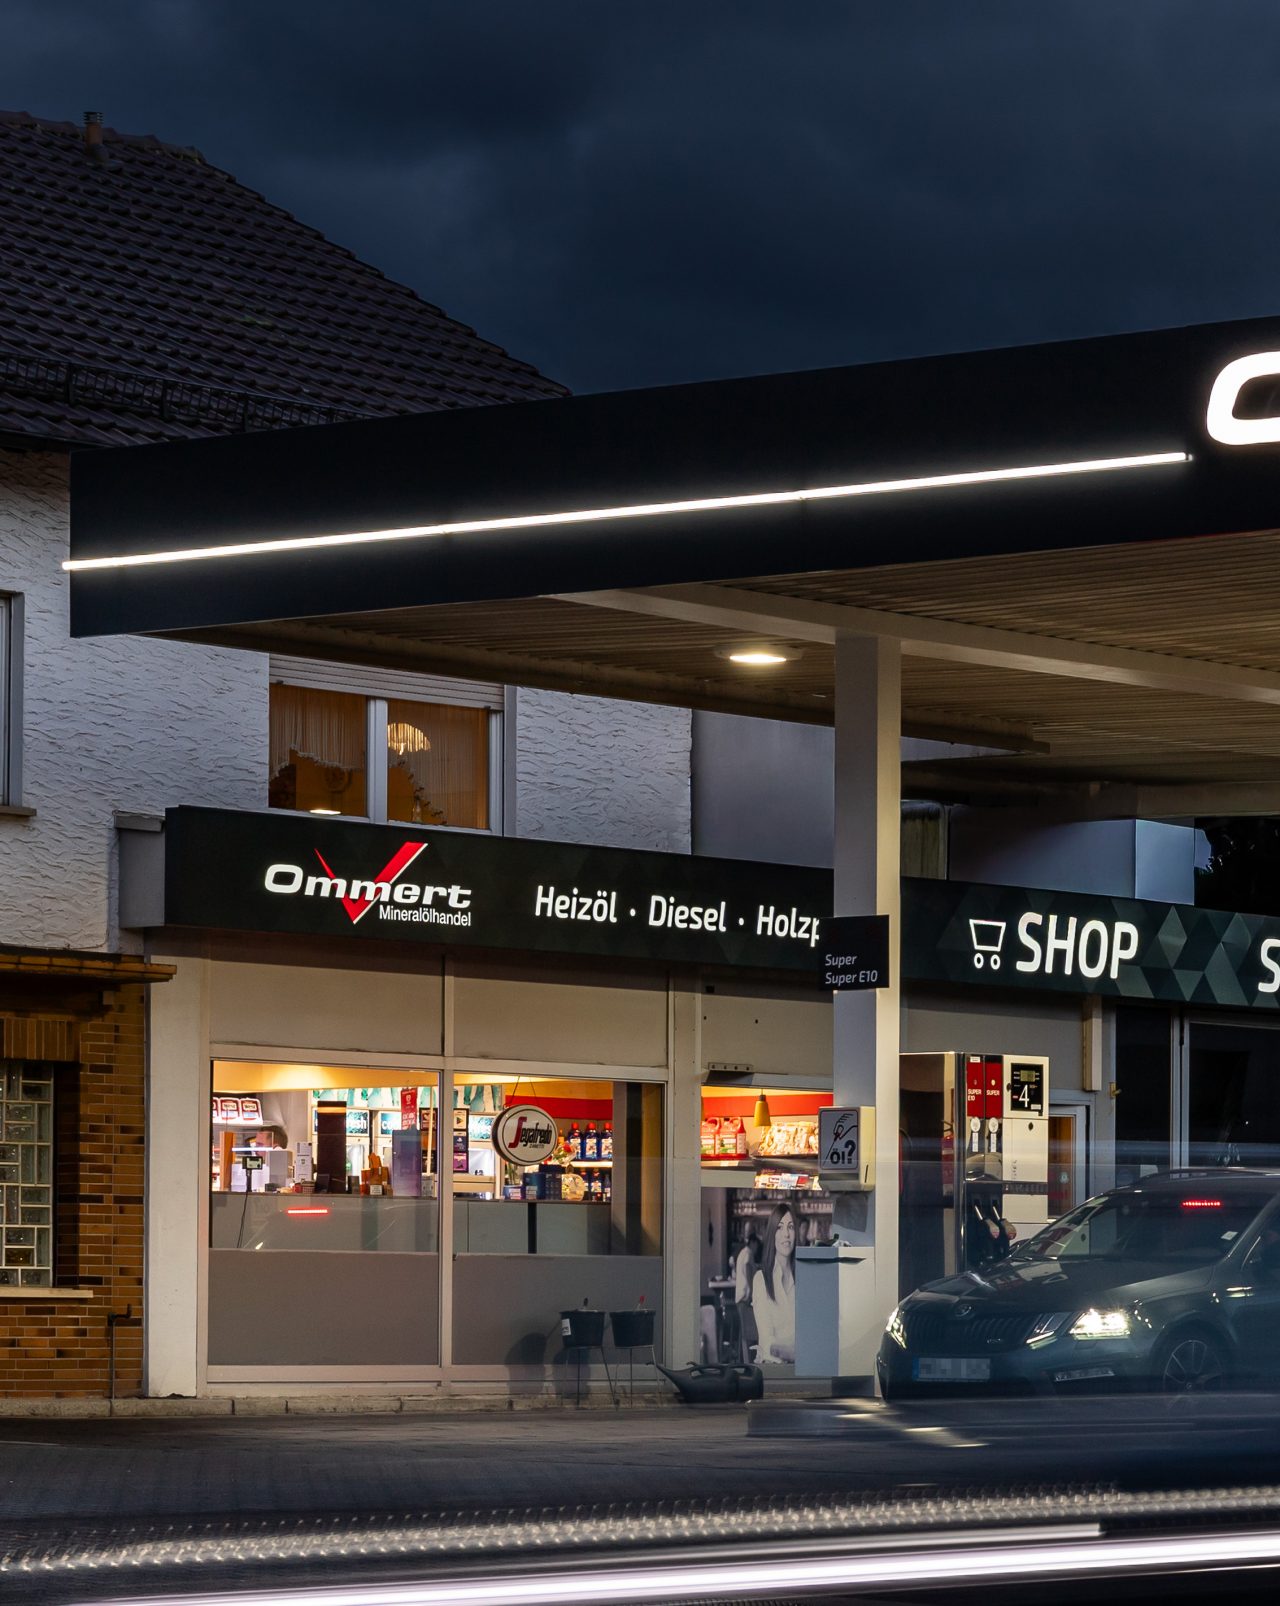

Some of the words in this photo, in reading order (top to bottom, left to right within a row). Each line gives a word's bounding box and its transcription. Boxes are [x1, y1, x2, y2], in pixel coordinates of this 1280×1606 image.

[264, 863, 472, 909] Ommert
[379, 904, 472, 927] Mineralölhandel
[534, 884, 618, 923] Heizöl
[648, 894, 727, 932] Diesel
[1015, 911, 1140, 980] SHOP
[825, 954, 857, 968] Super
[825, 972, 857, 986] Super
[858, 970, 879, 983] E10
[1018, 1084, 1030, 1108] 4
[829, 1139, 857, 1165] Öl?
